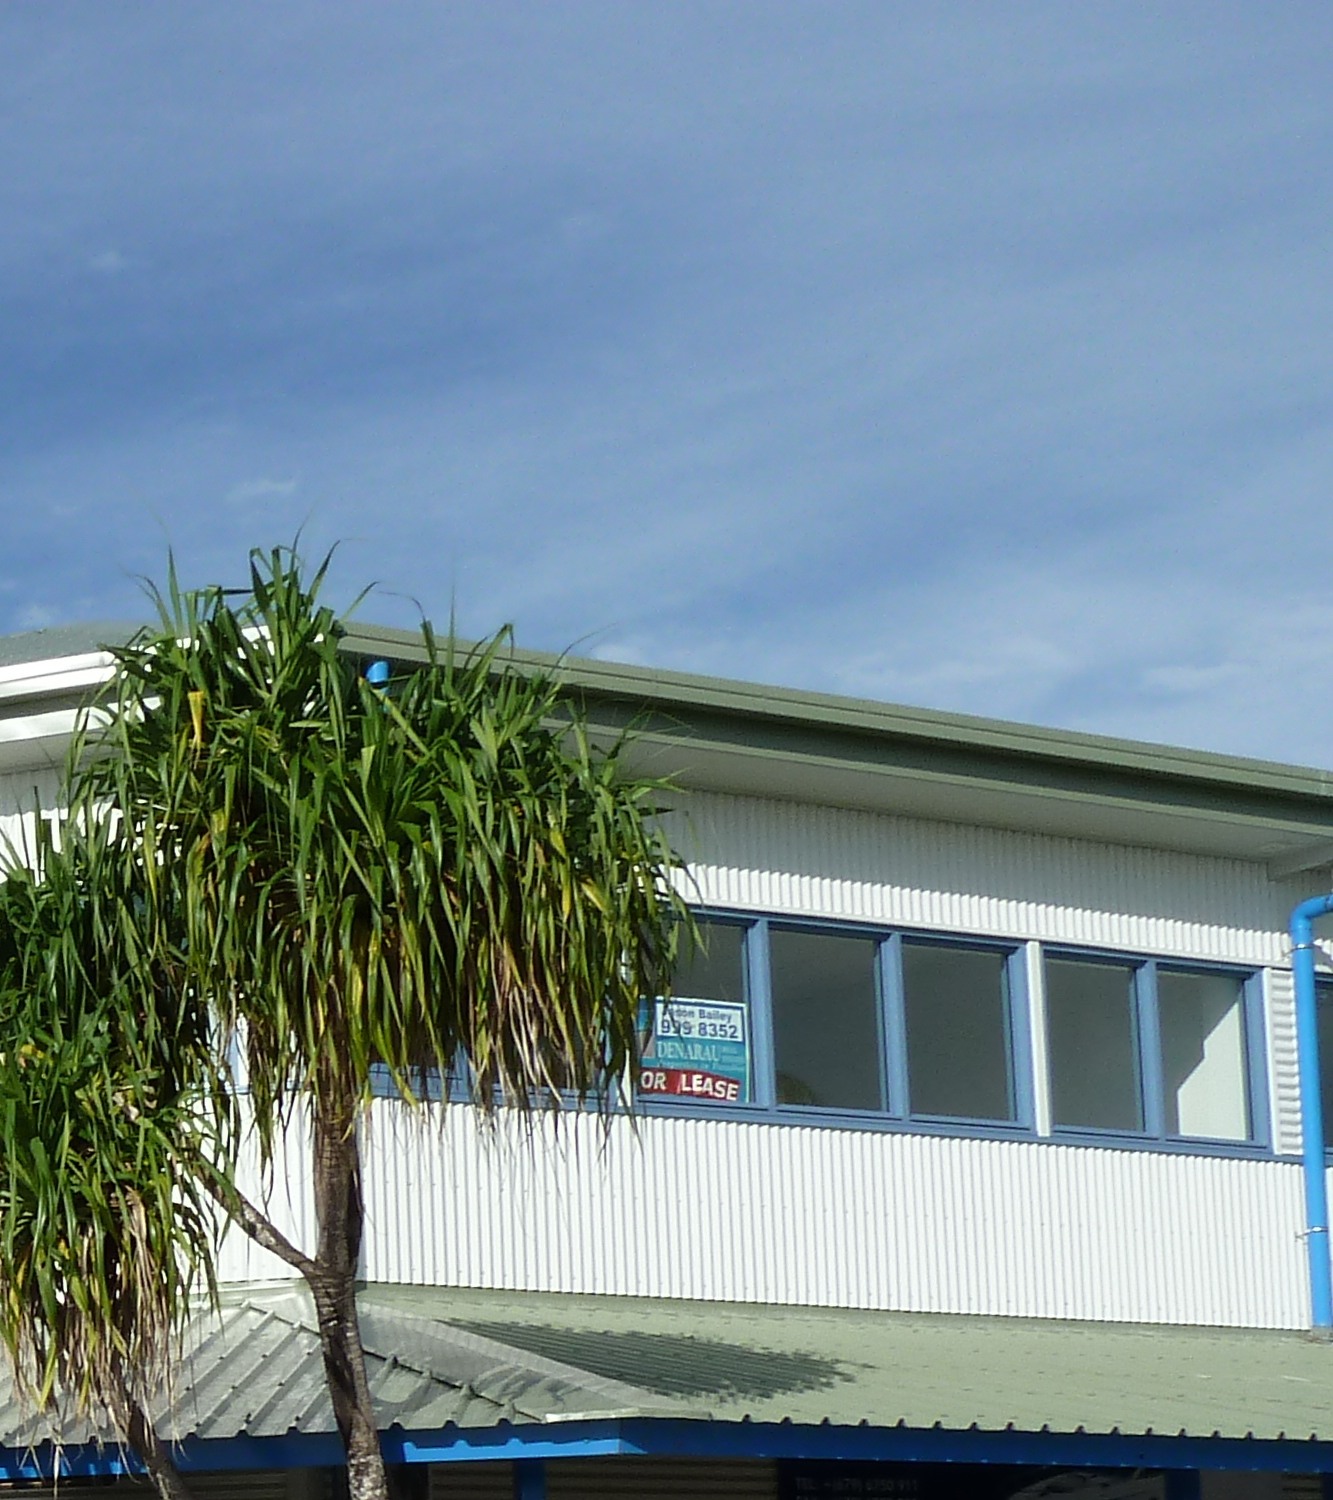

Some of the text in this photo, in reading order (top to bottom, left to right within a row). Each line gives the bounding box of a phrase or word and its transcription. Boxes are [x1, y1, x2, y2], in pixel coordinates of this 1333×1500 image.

[699, 1008, 732, 1023] Bailey
[698, 1022, 738, 1039] 8352
[640, 1071, 739, 1101] OR LEASE
